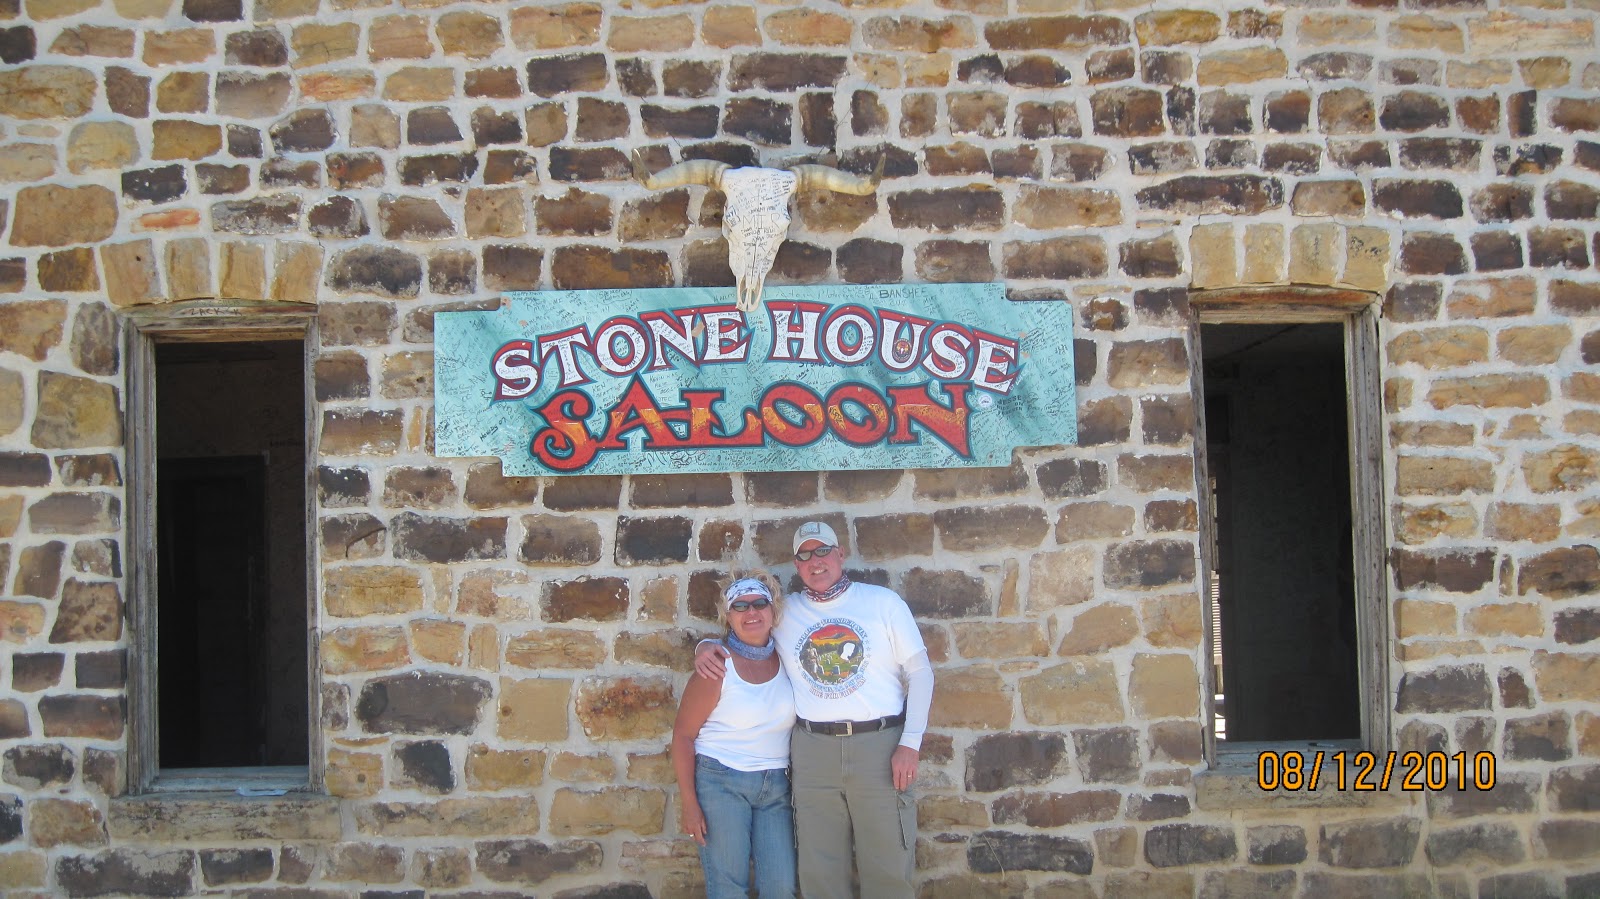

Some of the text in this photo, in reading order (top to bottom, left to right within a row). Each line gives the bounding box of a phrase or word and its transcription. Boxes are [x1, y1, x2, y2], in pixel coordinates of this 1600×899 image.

[879, 286, 928, 299] BANSHEE
[492, 304, 752, 402] STONE
[764, 300, 1021, 396] HOUSE
[530, 374, 975, 472] SALOON
